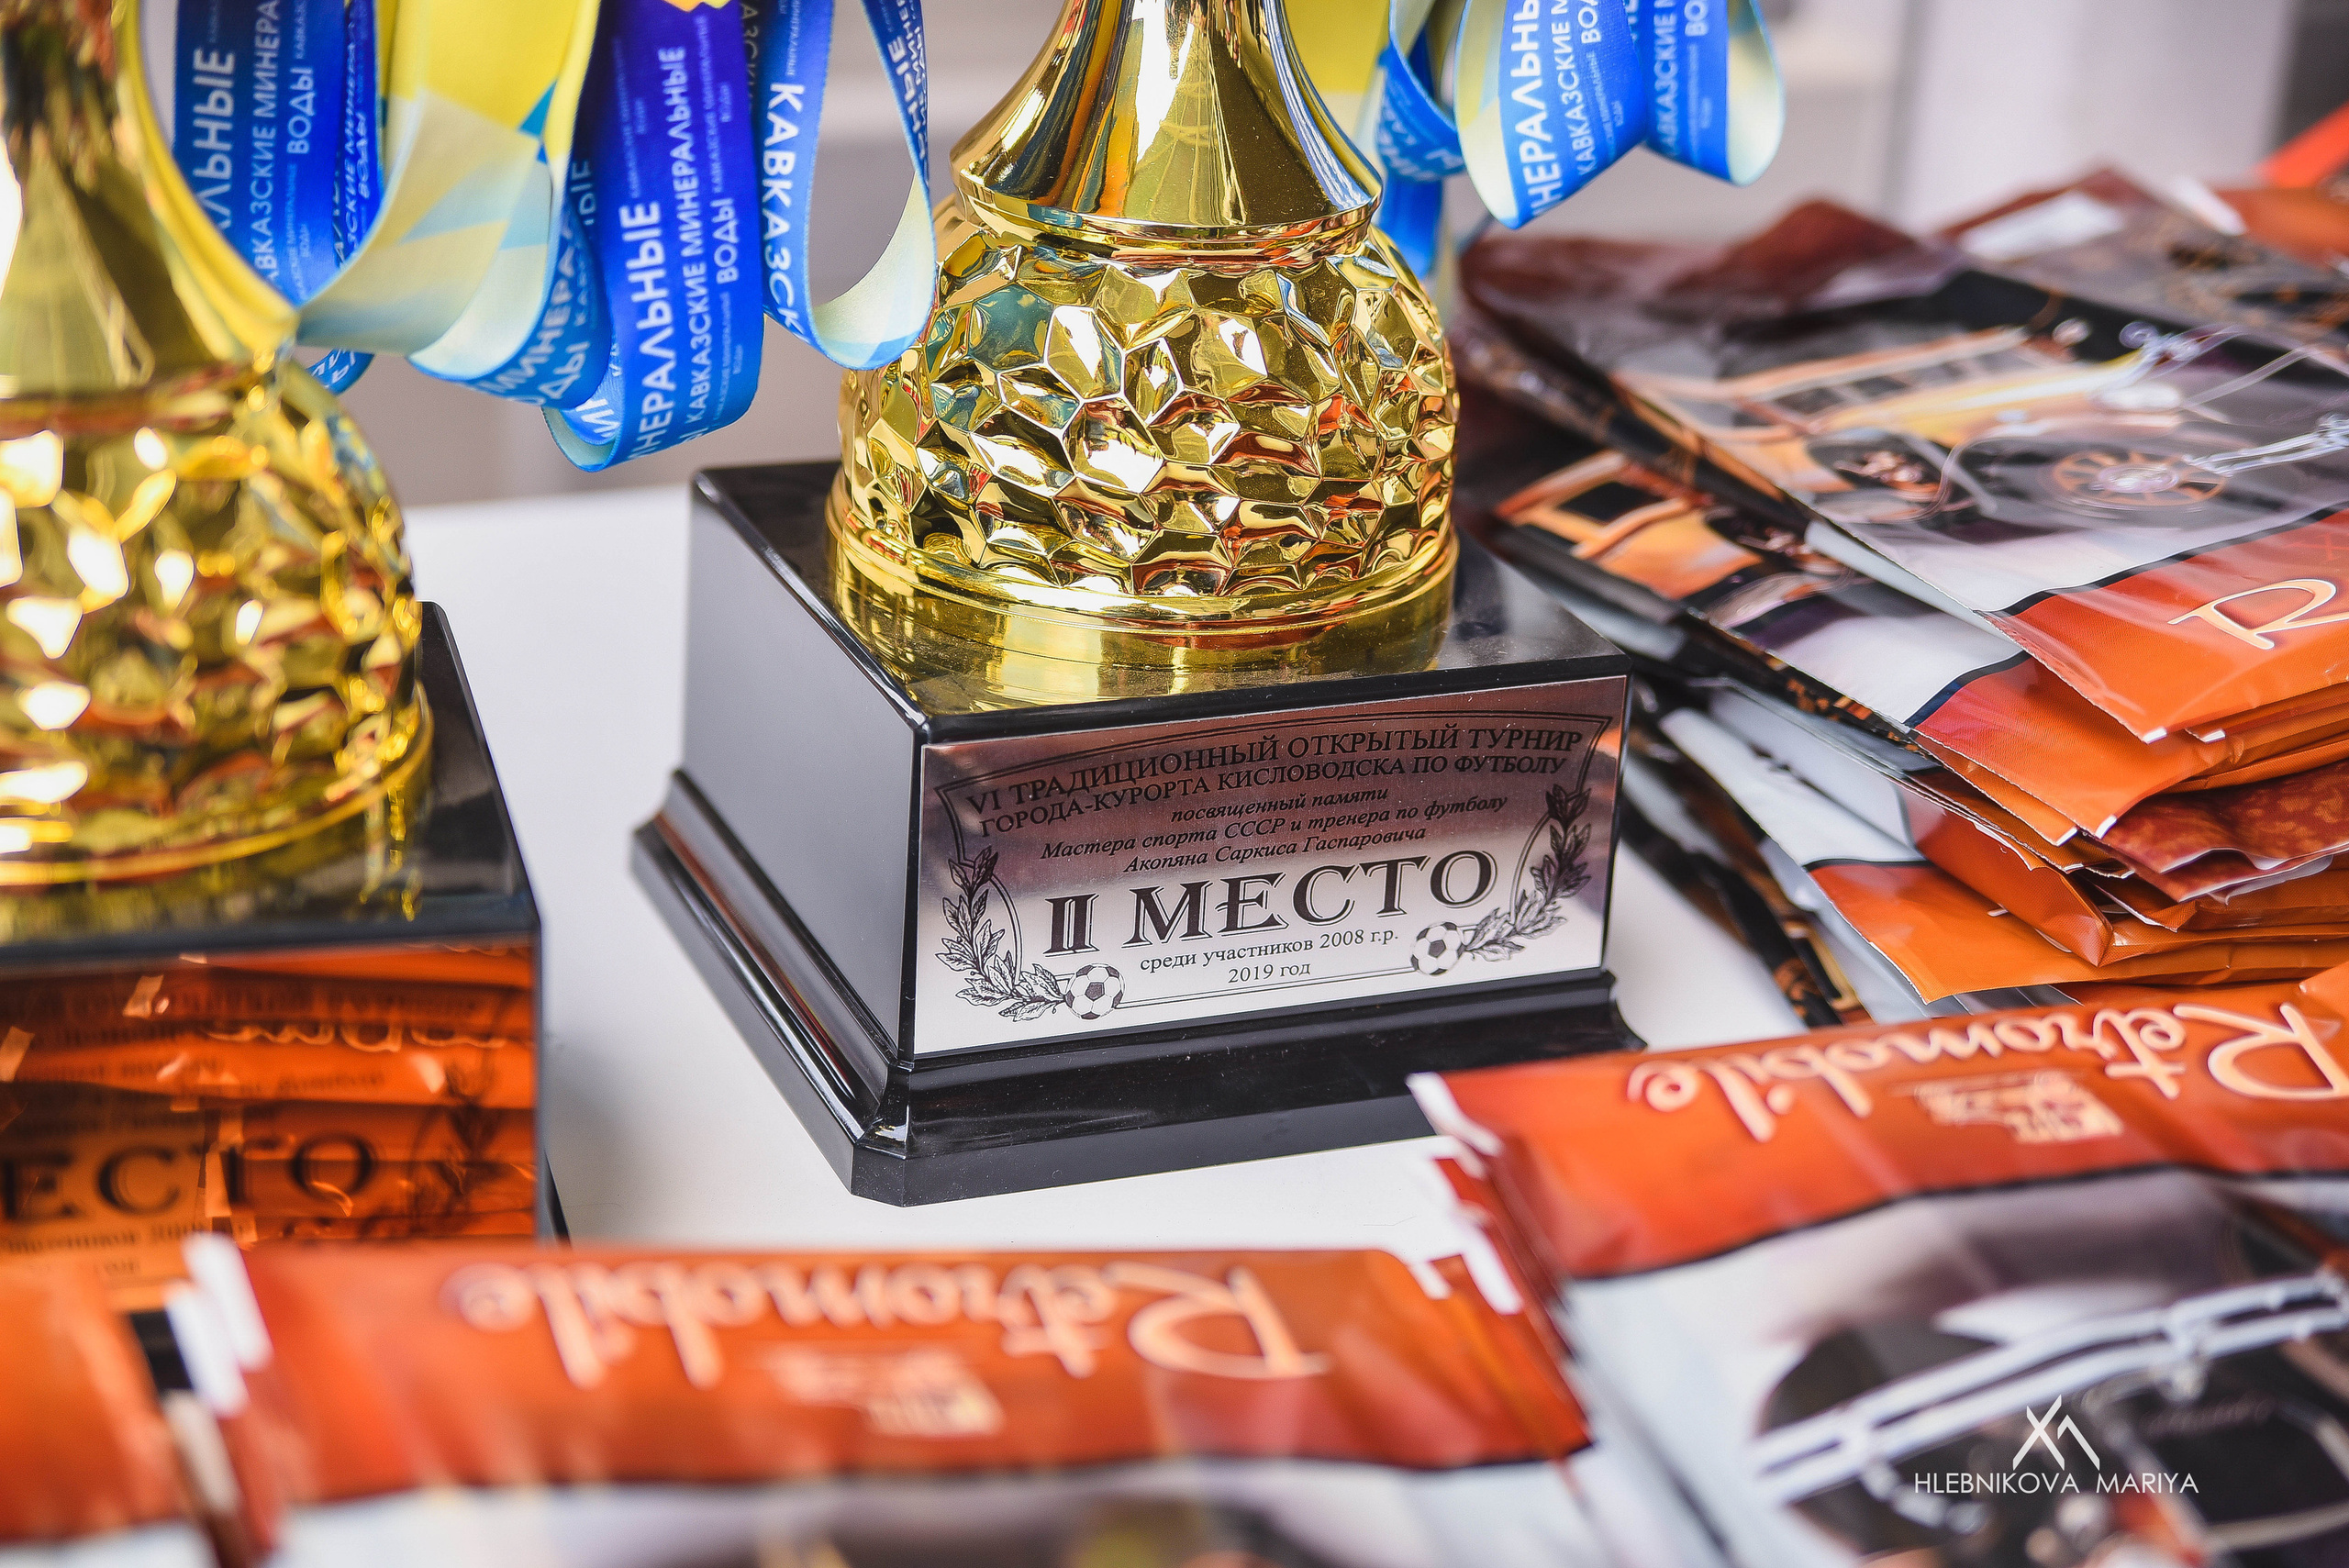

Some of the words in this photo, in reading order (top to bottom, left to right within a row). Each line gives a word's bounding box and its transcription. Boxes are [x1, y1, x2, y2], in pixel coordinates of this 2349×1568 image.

[286, 67, 315, 154] ВОДЫ
[1551, 21, 1598, 176] КАВКАЗСКИЕ
[657, 46, 705, 258] МИНЕРАЛЬНЫЕ
[709, 197, 740, 285] ВОДЫ
[684, 261, 713, 425] КАВКАЗСКИЕ
[967, 790, 1002, 815] VI
[1010, 735, 1279, 806] ТРАДИЦИОННЫЙ
[1287, 723, 1459, 757] ОТКРЫТЫЙ
[1469, 727, 1582, 752] ТУРНИР
[979, 781, 1210, 837] ГОРОДА-КУРОРТА
[1218, 757, 1405, 789] КИСЛОВОДСКА
[1411, 755, 1448, 773] ПО
[1453, 754, 1567, 774] ФУТБОЛУ
[1171, 794, 1307, 823] посвященный
[1311, 787, 1389, 808] памяти
[1041, 838, 1136, 860] Мастера
[1141, 829, 1218, 853] спорта
[1224, 817, 1286, 840] СССР
[1289, 819, 1303, 833] и
[1307, 810, 1390, 835] тренера
[1395, 806, 1420, 822] по
[1424, 795, 1508, 822] футболу
[1123, 853, 1208, 873] Акопяна
[1215, 842, 1297, 866] Саркиса
[1302, 828, 1427, 854] Гаспаровича
[1121, 850, 1498, 949] МЕСТО
[1139, 951, 1197, 973] среди
[1203, 938, 1314, 969] участников
[1319, 929, 1364, 950] 2008
[1370, 928, 1399, 946] г.р.
[1227, 962, 1274, 984] 2019
[1280, 962, 1311, 979] год
[1628, 1002, 2349, 1142] Retromobile
[451, 1262, 1330, 1391] Retromobile
